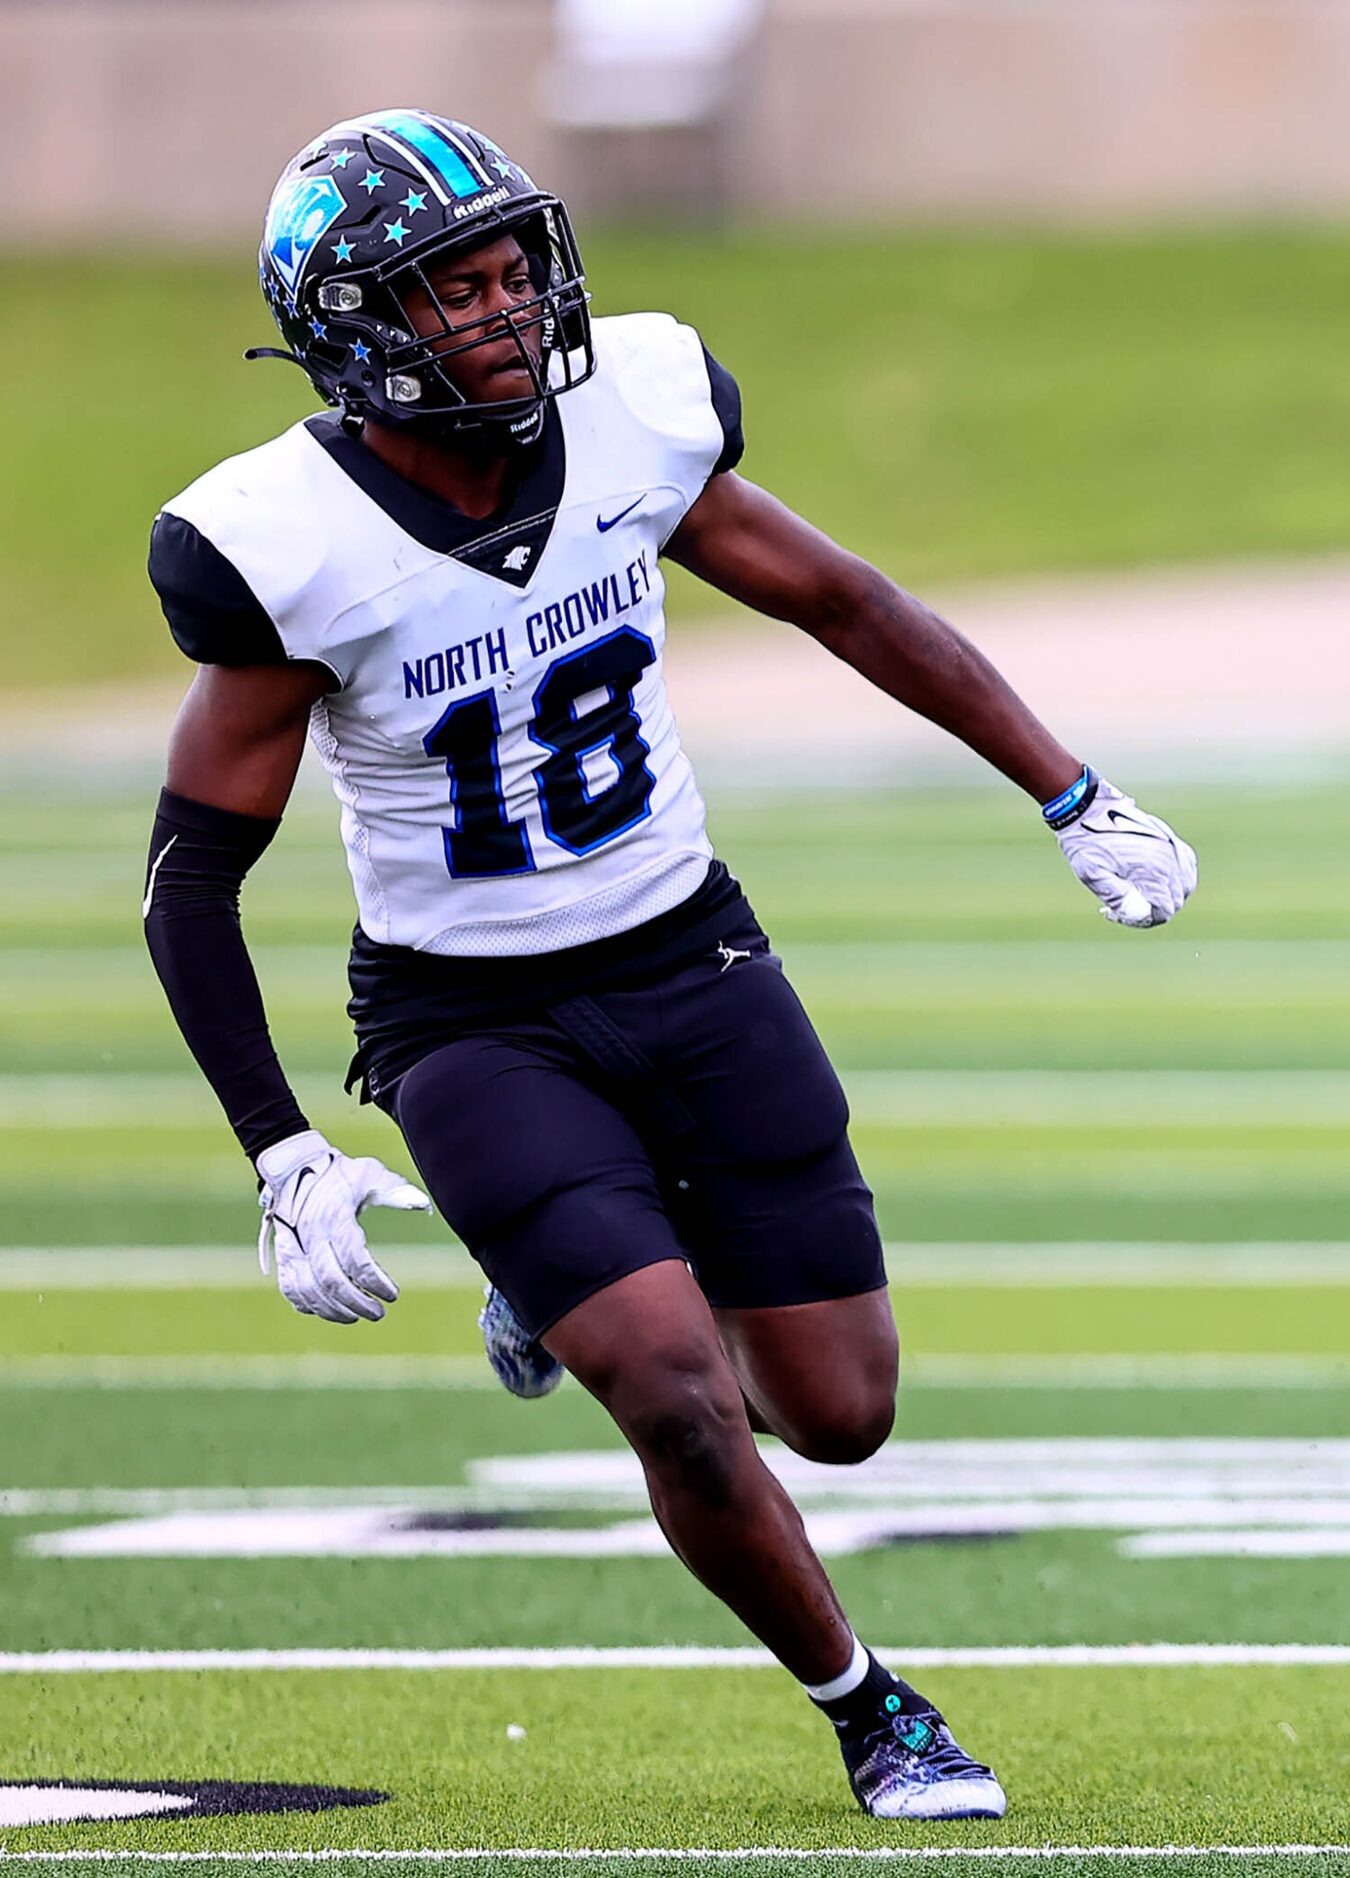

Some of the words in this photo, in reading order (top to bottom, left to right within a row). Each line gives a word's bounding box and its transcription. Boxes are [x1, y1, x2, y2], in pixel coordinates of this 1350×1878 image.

[403, 627, 509, 699] NORTH
[526, 549, 651, 658] CROWLEY
[423, 624, 657, 879] 18
